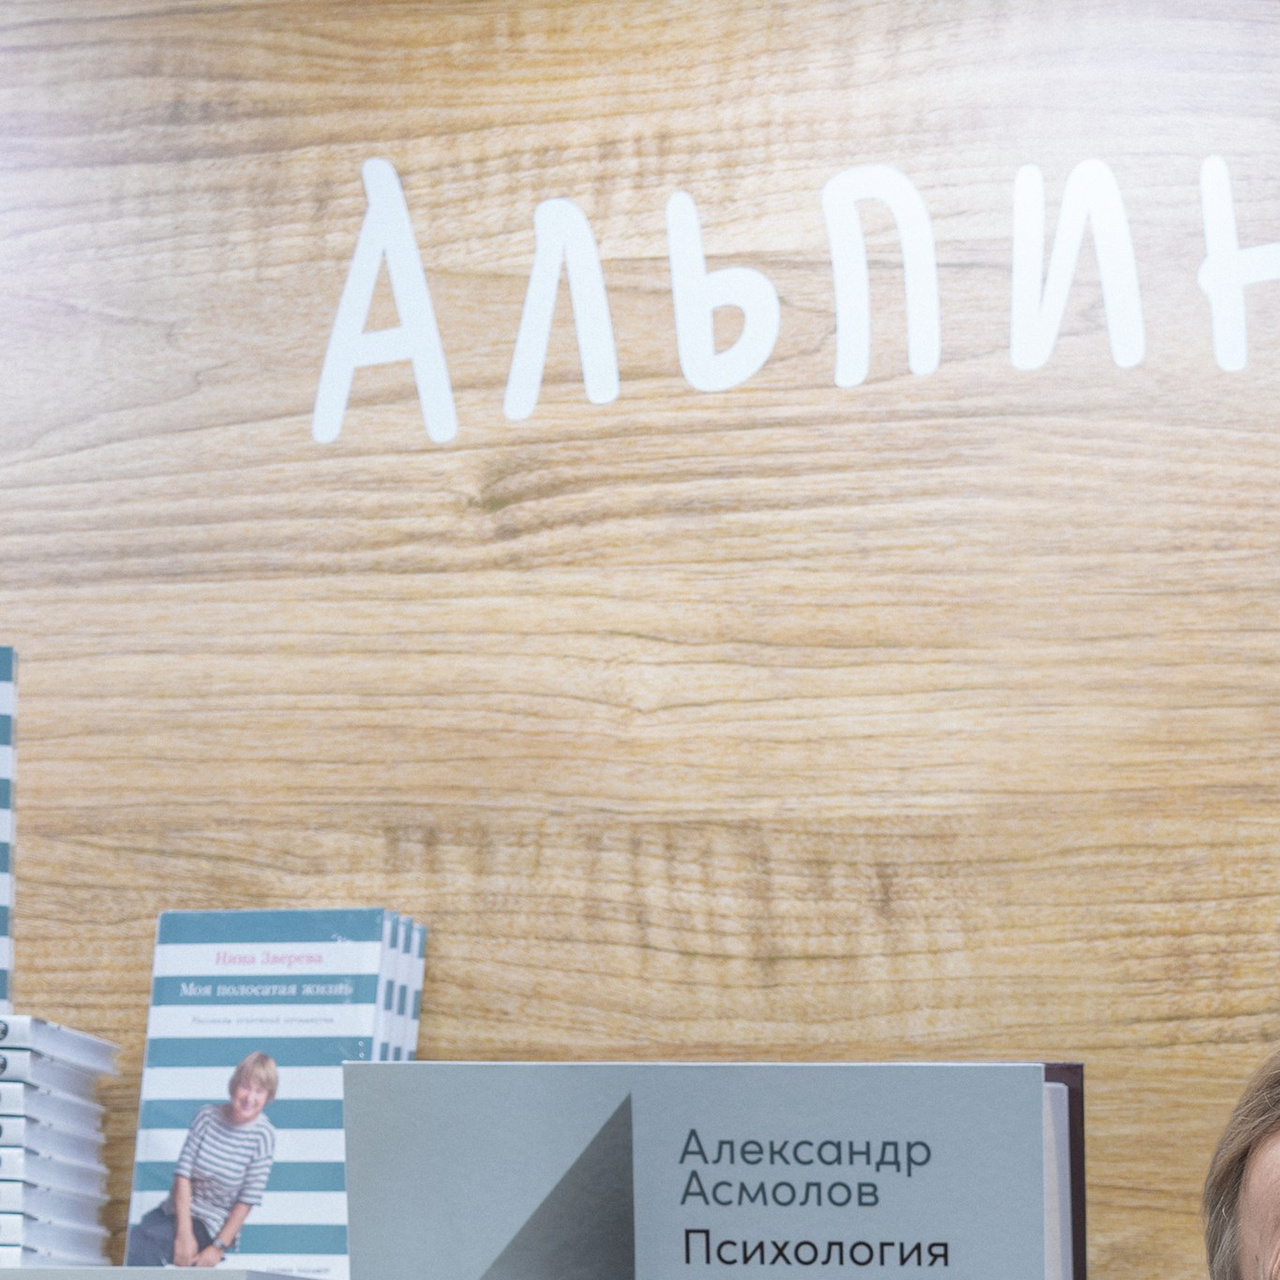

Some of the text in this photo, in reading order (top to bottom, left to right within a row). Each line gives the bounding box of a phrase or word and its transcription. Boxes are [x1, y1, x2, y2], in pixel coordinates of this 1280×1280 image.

[215, 951, 324, 968] Нина Зверева
[179, 982, 353, 997] Моя полосатая жизнь
[679, 1128, 931, 1177] Александр
[680, 1170, 879, 1207] Асмолов
[684, 1229, 949, 1267] Психология
